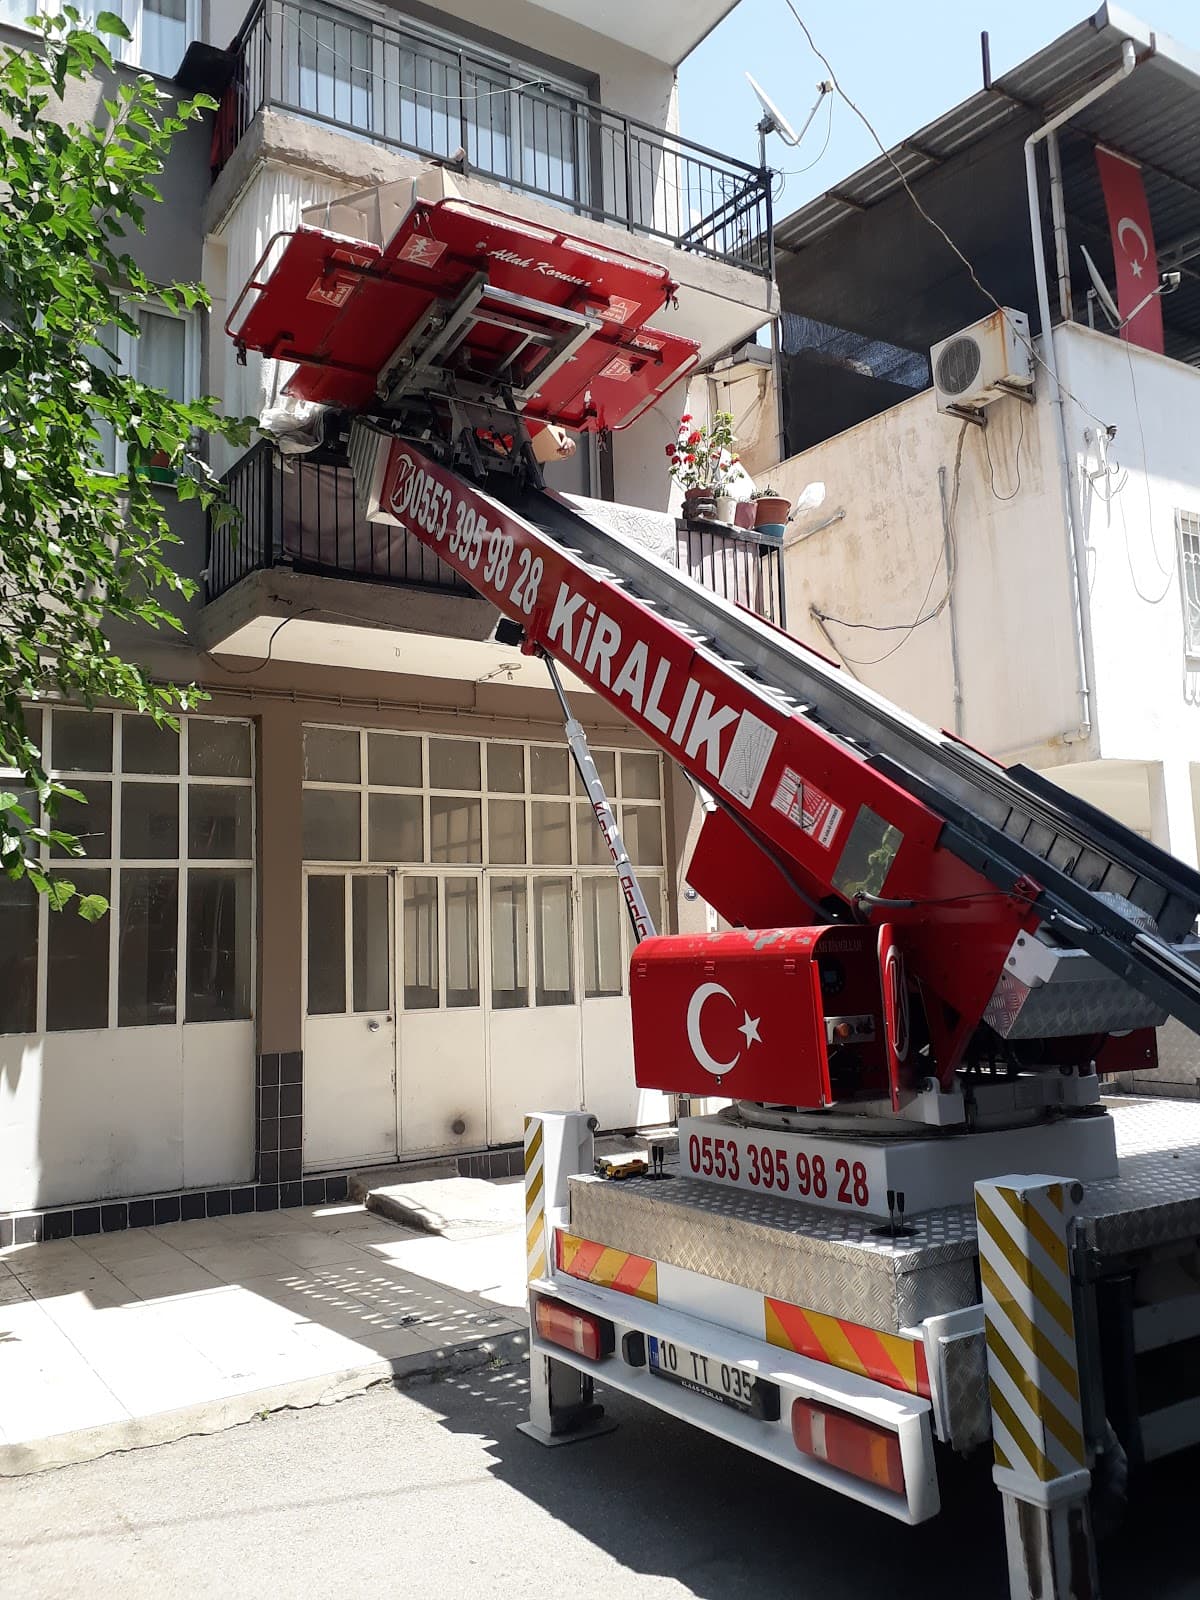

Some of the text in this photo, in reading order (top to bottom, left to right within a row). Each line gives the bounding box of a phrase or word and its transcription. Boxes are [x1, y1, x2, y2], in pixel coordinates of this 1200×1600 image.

[487, 249, 534, 268] Allah
[409, 468, 544, 615] 0553 395 98 28
[688, 1134, 870, 1207] 0553 395 98 28
[660, 1340, 752, 1402] 10 TT 035
